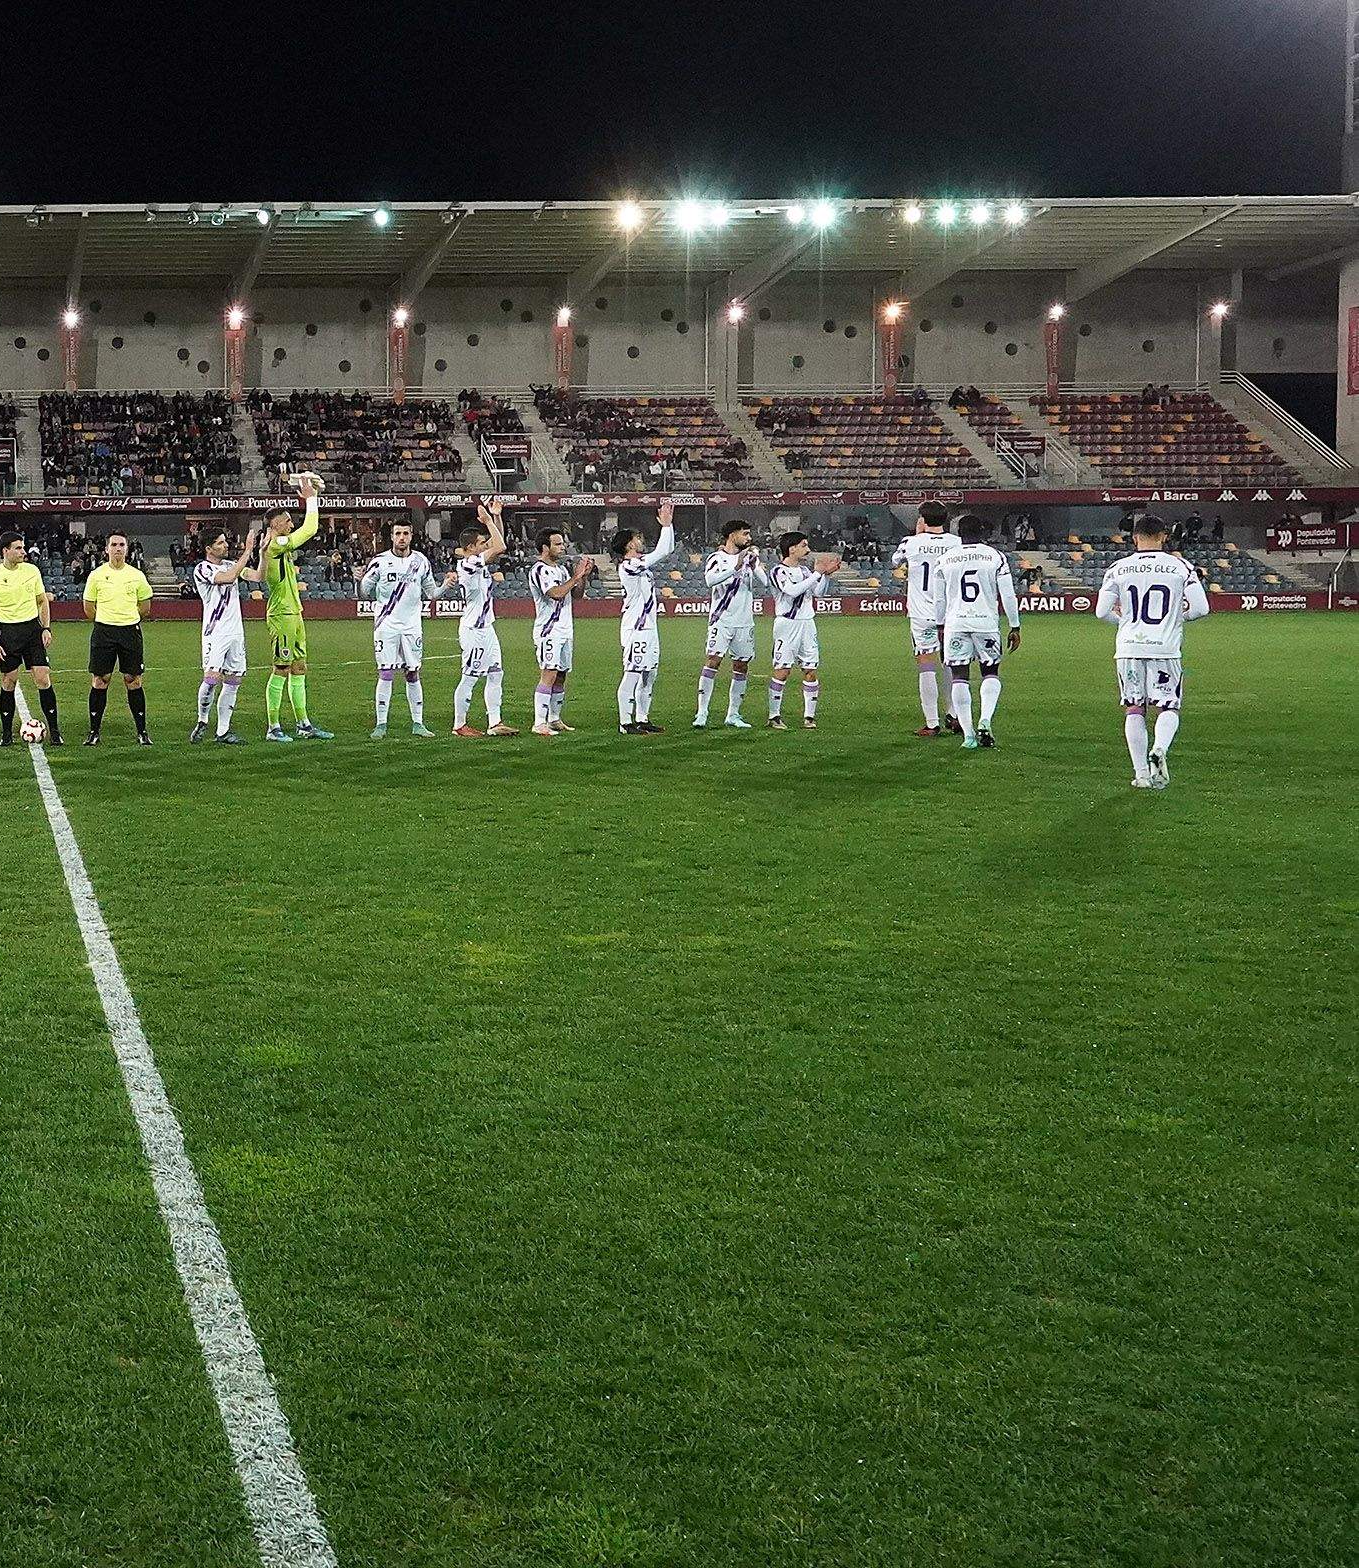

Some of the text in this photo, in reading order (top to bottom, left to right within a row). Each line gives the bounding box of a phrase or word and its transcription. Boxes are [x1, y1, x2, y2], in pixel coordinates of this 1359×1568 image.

[1152, 491, 1199, 500] A Barca
[210, 498, 238, 508] Diario
[248, 498, 299, 508] Pontevedra
[317, 497, 345, 507] Diario
[355, 497, 406, 507] Pontevedra
[1297, 528, 1336, 537] Deputación
[1297, 537, 1336, 545] Pontevedra
[1118, 564, 1152, 576] CARLOS
[922, 562, 930, 592] 1
[961, 570, 980, 602] 6
[675, 602, 710, 613] ACUÑ
[860, 600, 902, 612] Estrella
[1019, 597, 1064, 611] AFARI
[1127, 585, 1171, 625] 10
[711, 628, 718, 639] 9
[546, 639, 553, 651] 5
[634, 642, 647, 653] 22
[776, 640, 783, 651] 7
[475, 648, 484, 660] 17
